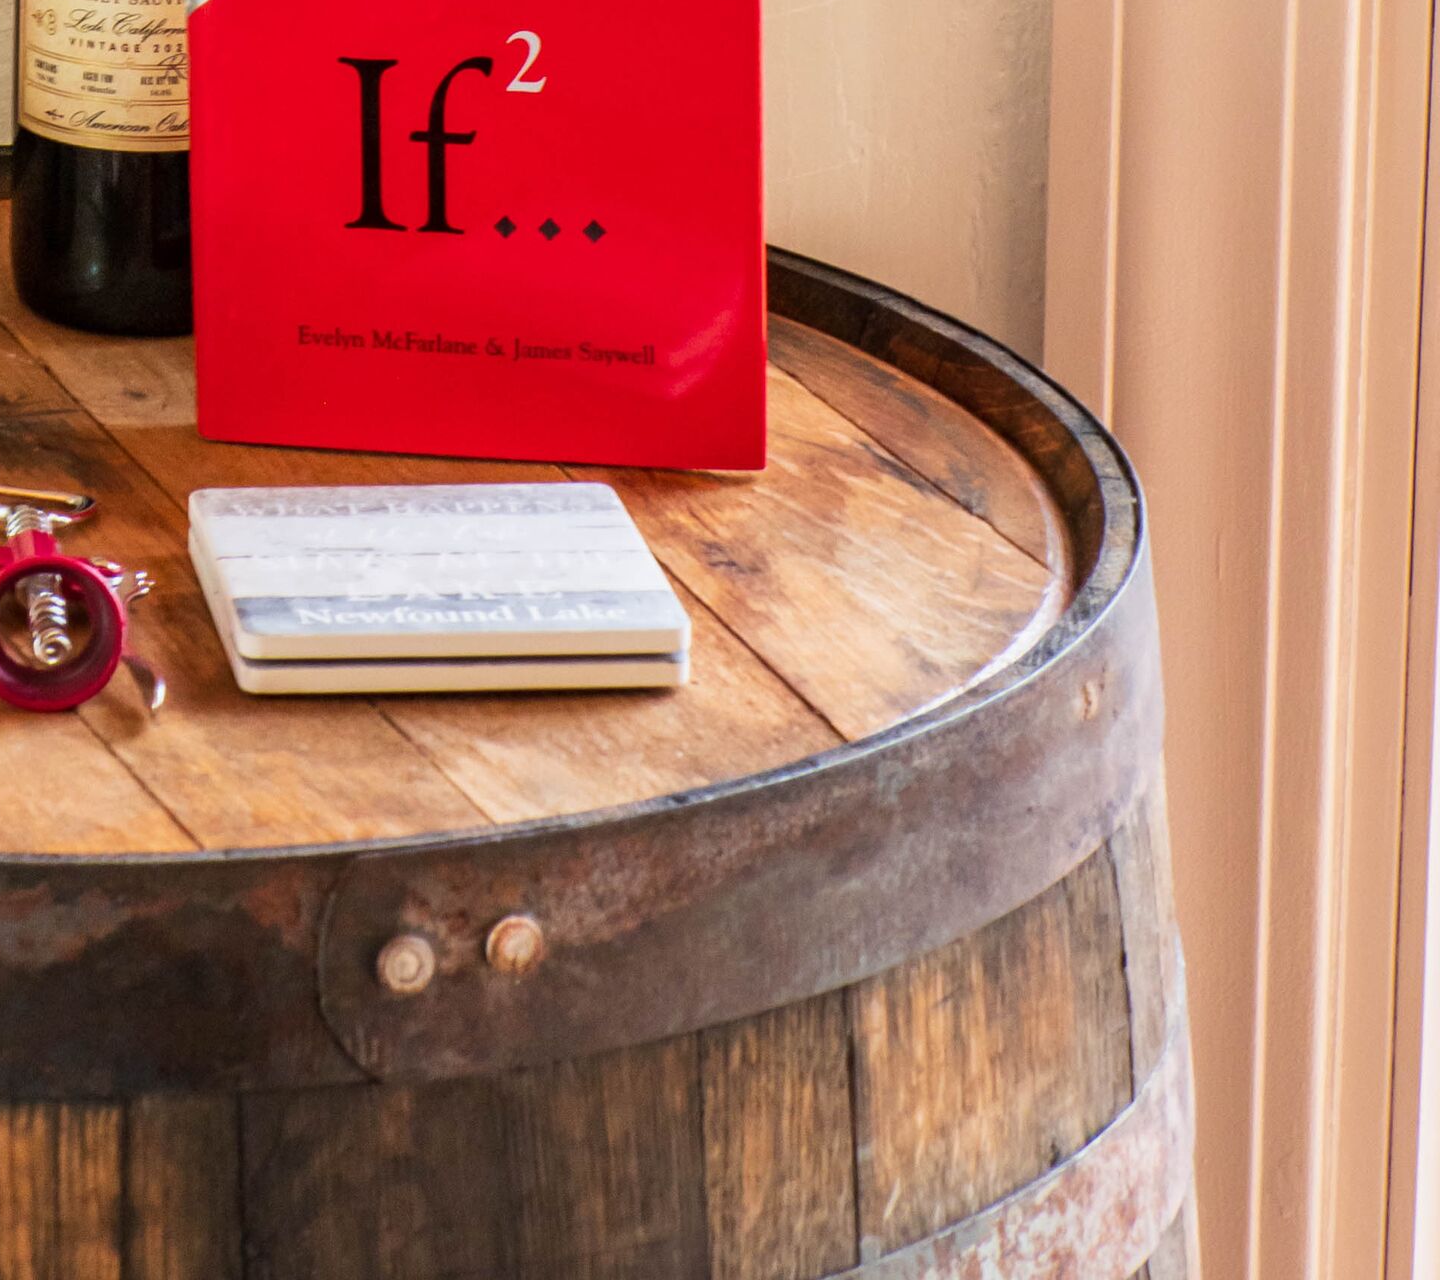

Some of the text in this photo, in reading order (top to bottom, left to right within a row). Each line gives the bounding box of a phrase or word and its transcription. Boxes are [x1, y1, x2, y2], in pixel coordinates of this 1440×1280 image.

[67, 36, 142, 54] VINTAGE
[69, 110, 150, 133] American
[296, 324, 656, 367] Evelyn McFarlane & James Saywell
[231, 500, 593, 517] WHAT HAPPENS
[345, 580, 564, 602] LAKE
[294, 603, 627, 626] Newfound Lake
